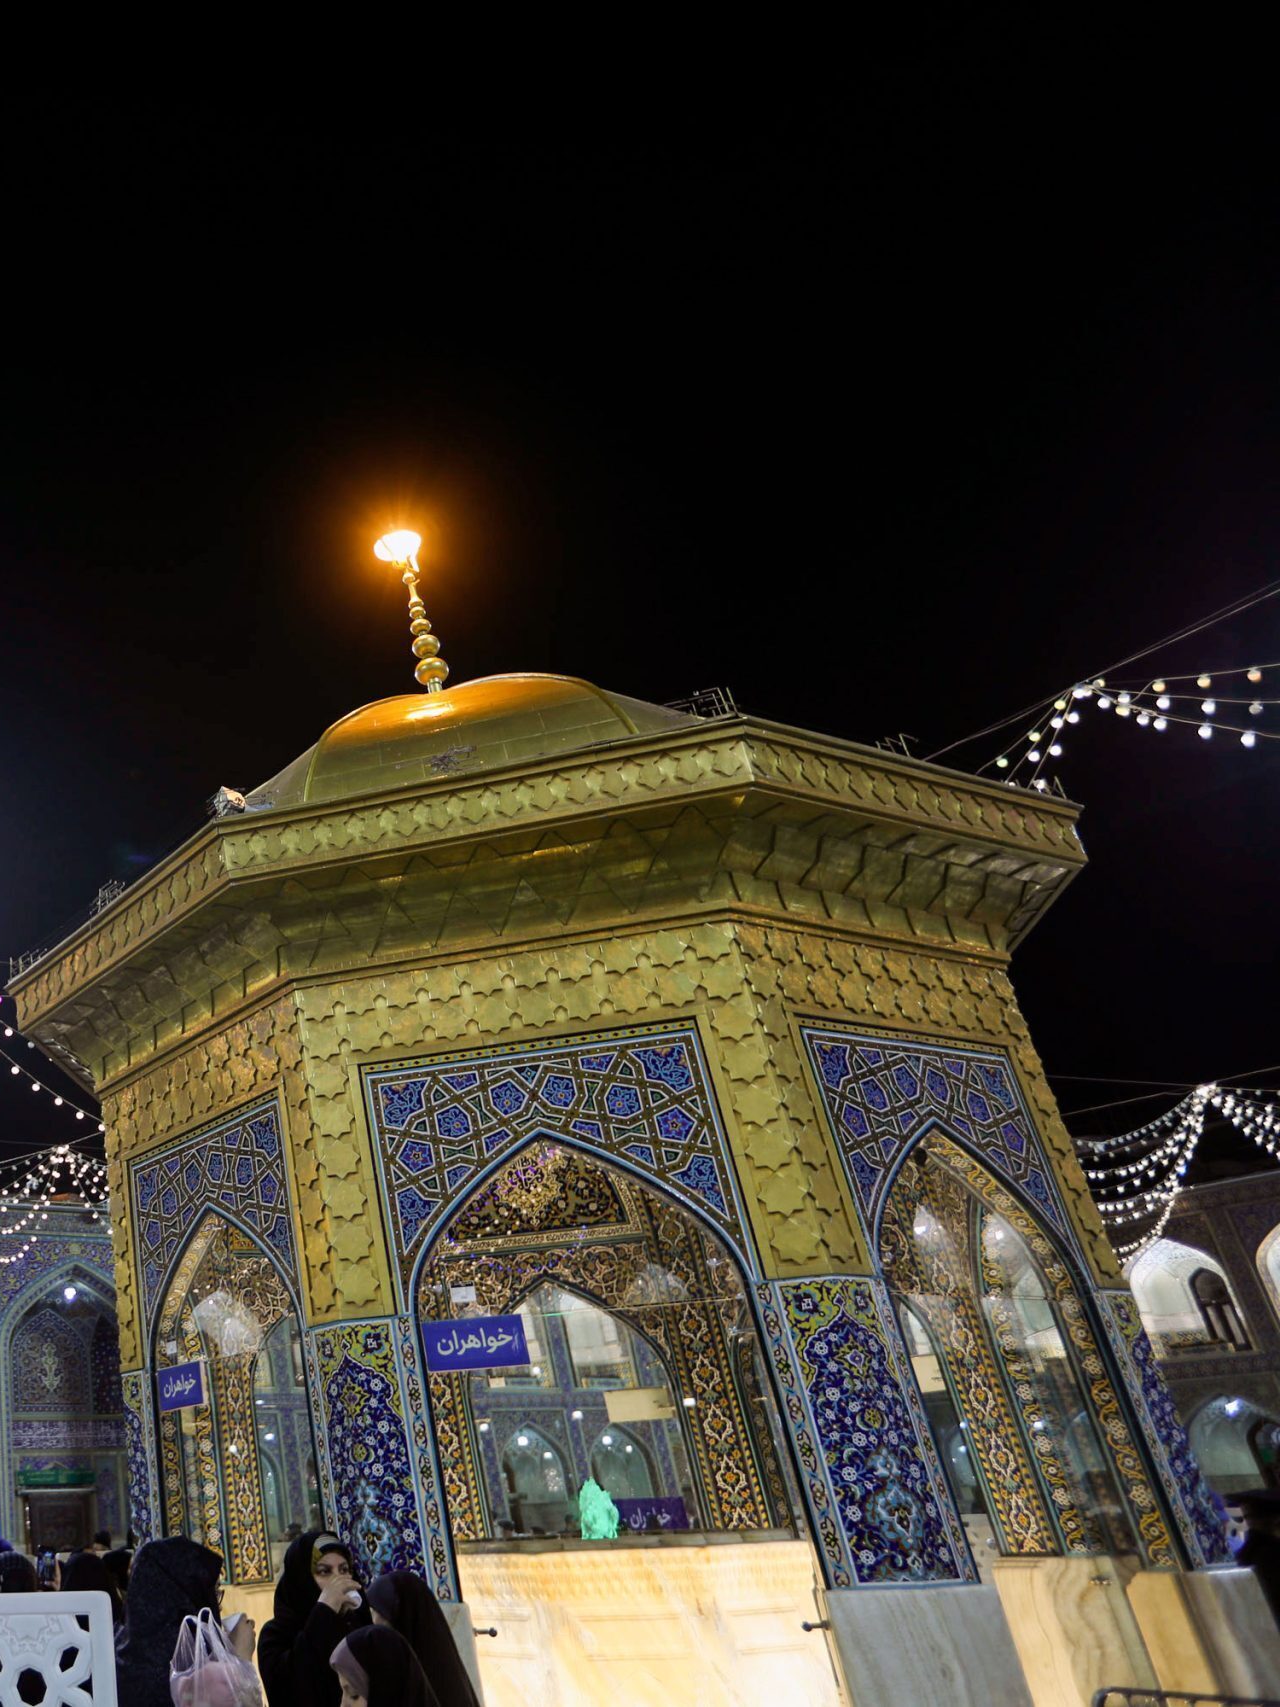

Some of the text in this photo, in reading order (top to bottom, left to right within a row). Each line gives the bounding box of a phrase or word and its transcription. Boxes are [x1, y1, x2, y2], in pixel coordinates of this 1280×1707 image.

[437, 1327, 513, 1356] خواهران
[163, 1373, 197, 1398] خواهران
[630, 1506, 671, 1529] خواران
